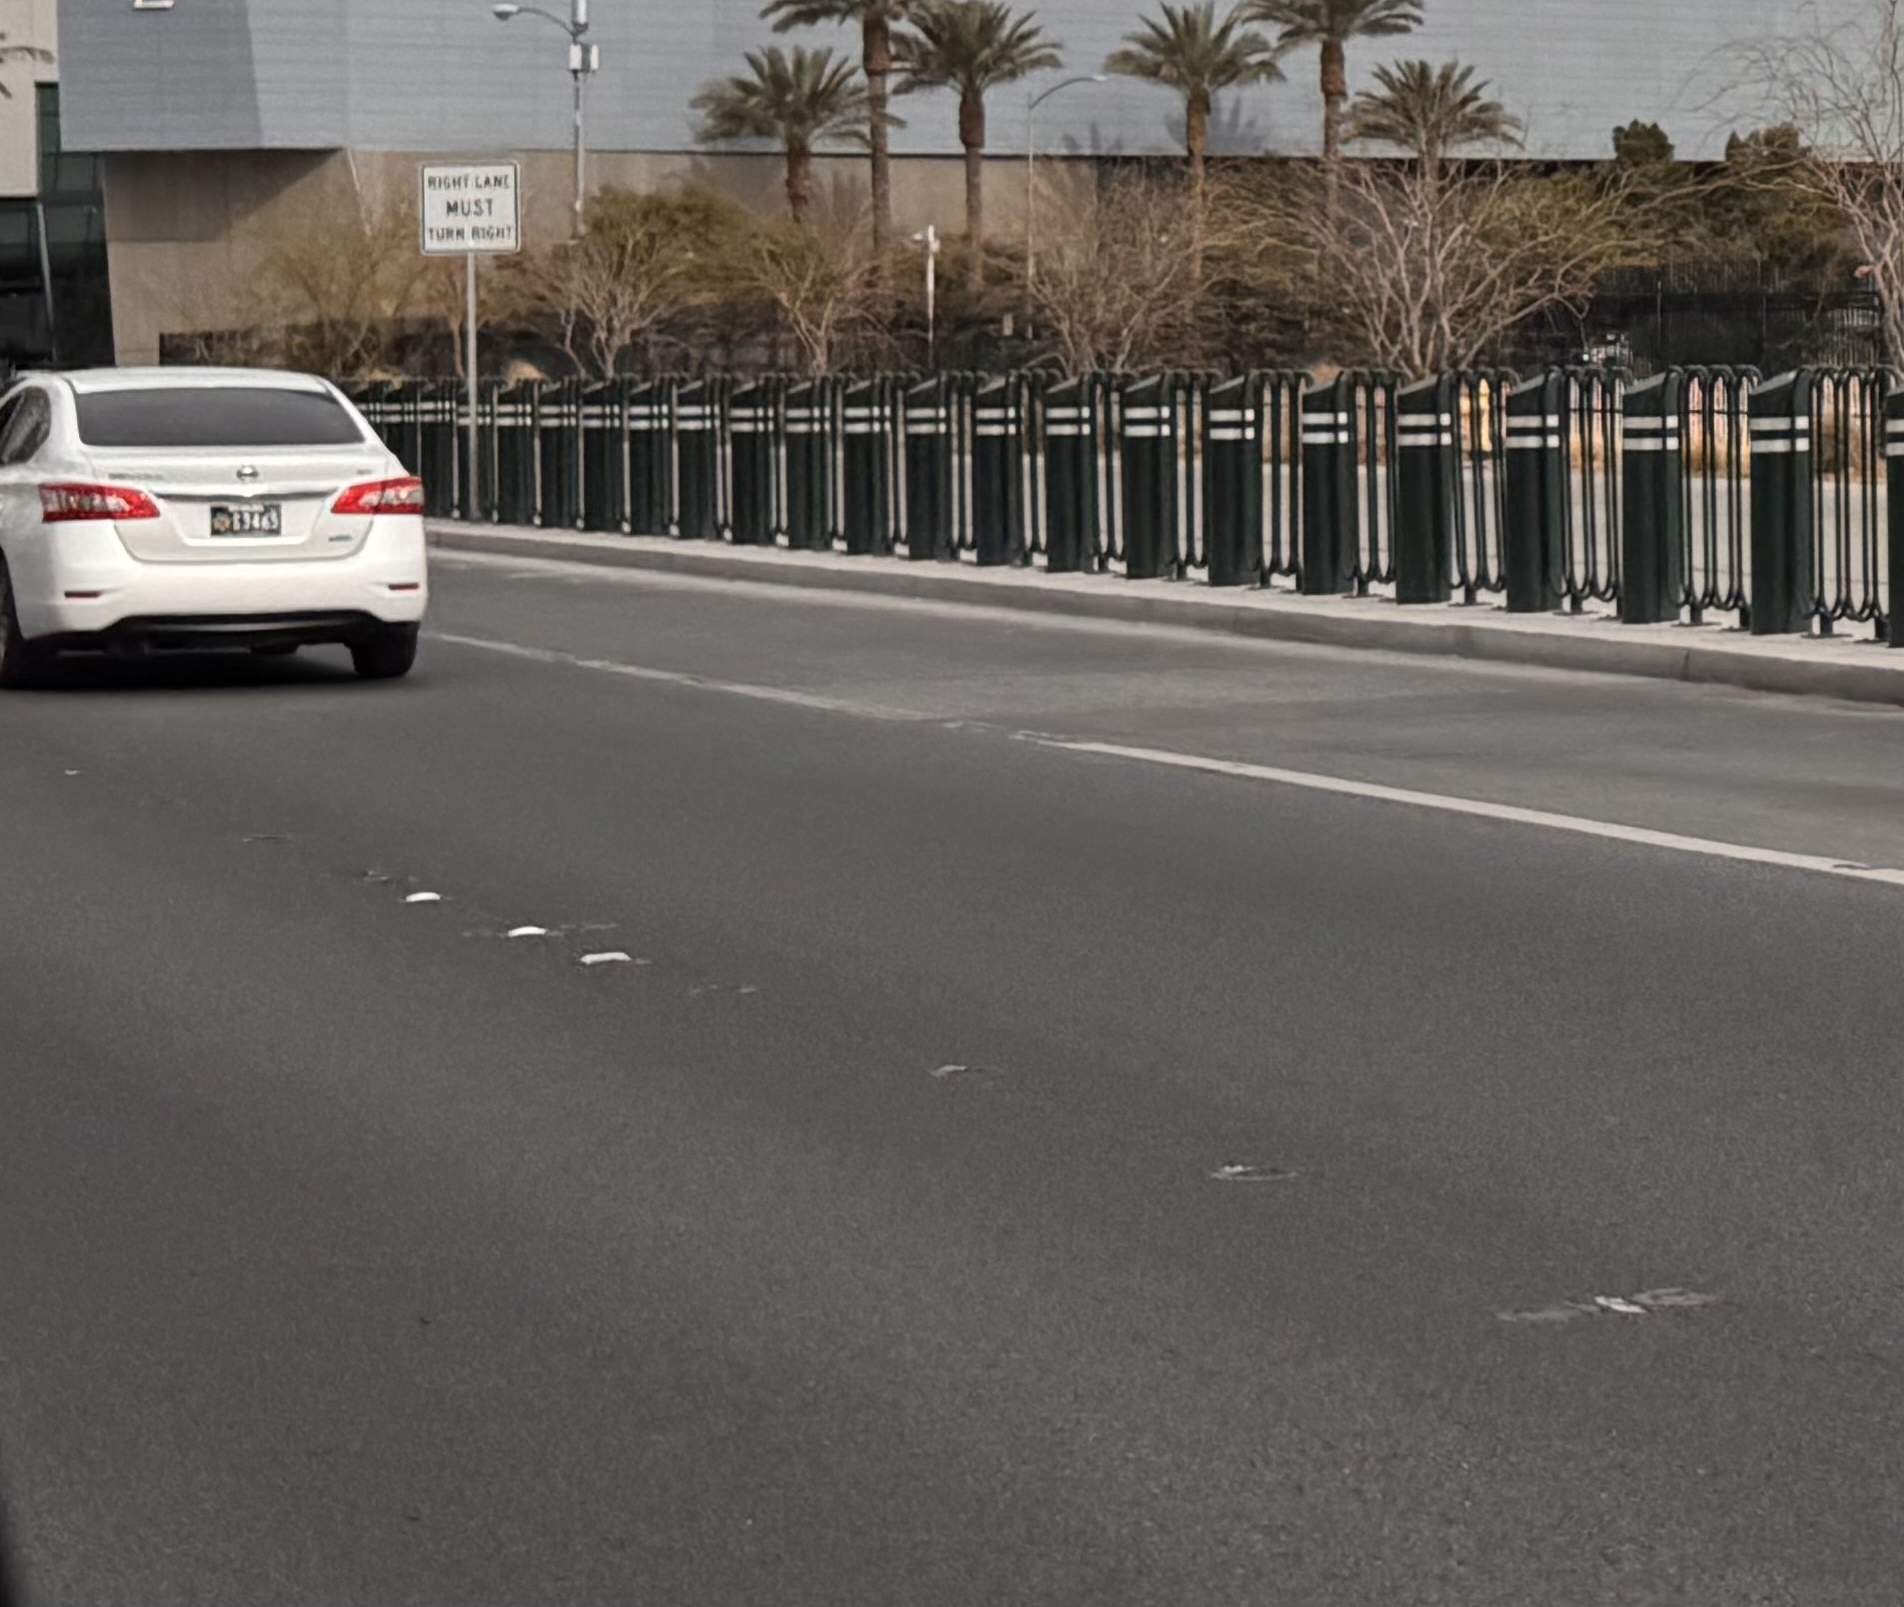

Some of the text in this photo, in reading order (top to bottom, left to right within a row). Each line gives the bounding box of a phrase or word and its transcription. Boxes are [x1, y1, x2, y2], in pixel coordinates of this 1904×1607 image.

[427, 175, 510, 190] RIGHT LANE
[446, 198, 493, 217] MUST
[428, 225, 511, 241] TURN RIGHT
